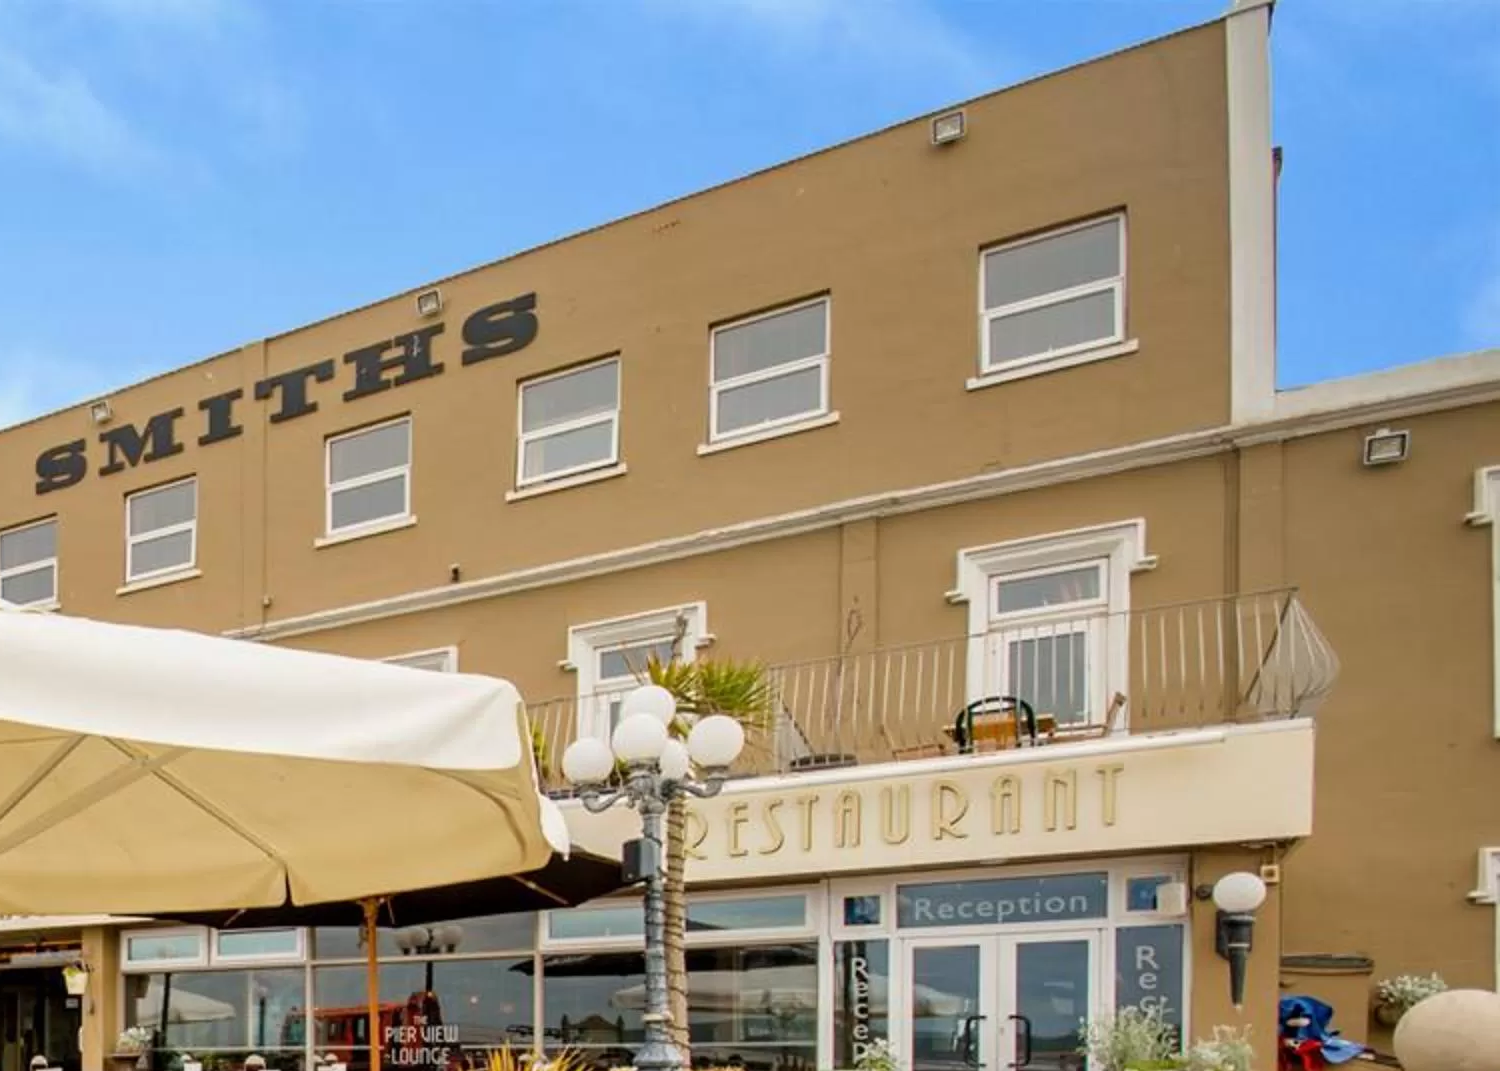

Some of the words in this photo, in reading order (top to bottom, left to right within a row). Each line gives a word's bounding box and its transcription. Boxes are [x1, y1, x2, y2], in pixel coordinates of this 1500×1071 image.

[35, 292, 539, 495] SMITHS
[683, 764, 1125, 861] RESTAURANT
[915, 890, 1088, 922] Reception
[384, 1026, 417, 1043] PIER
[420, 1024, 460, 1043] VIEW
[391, 1046, 451, 1065] LOUNGE
